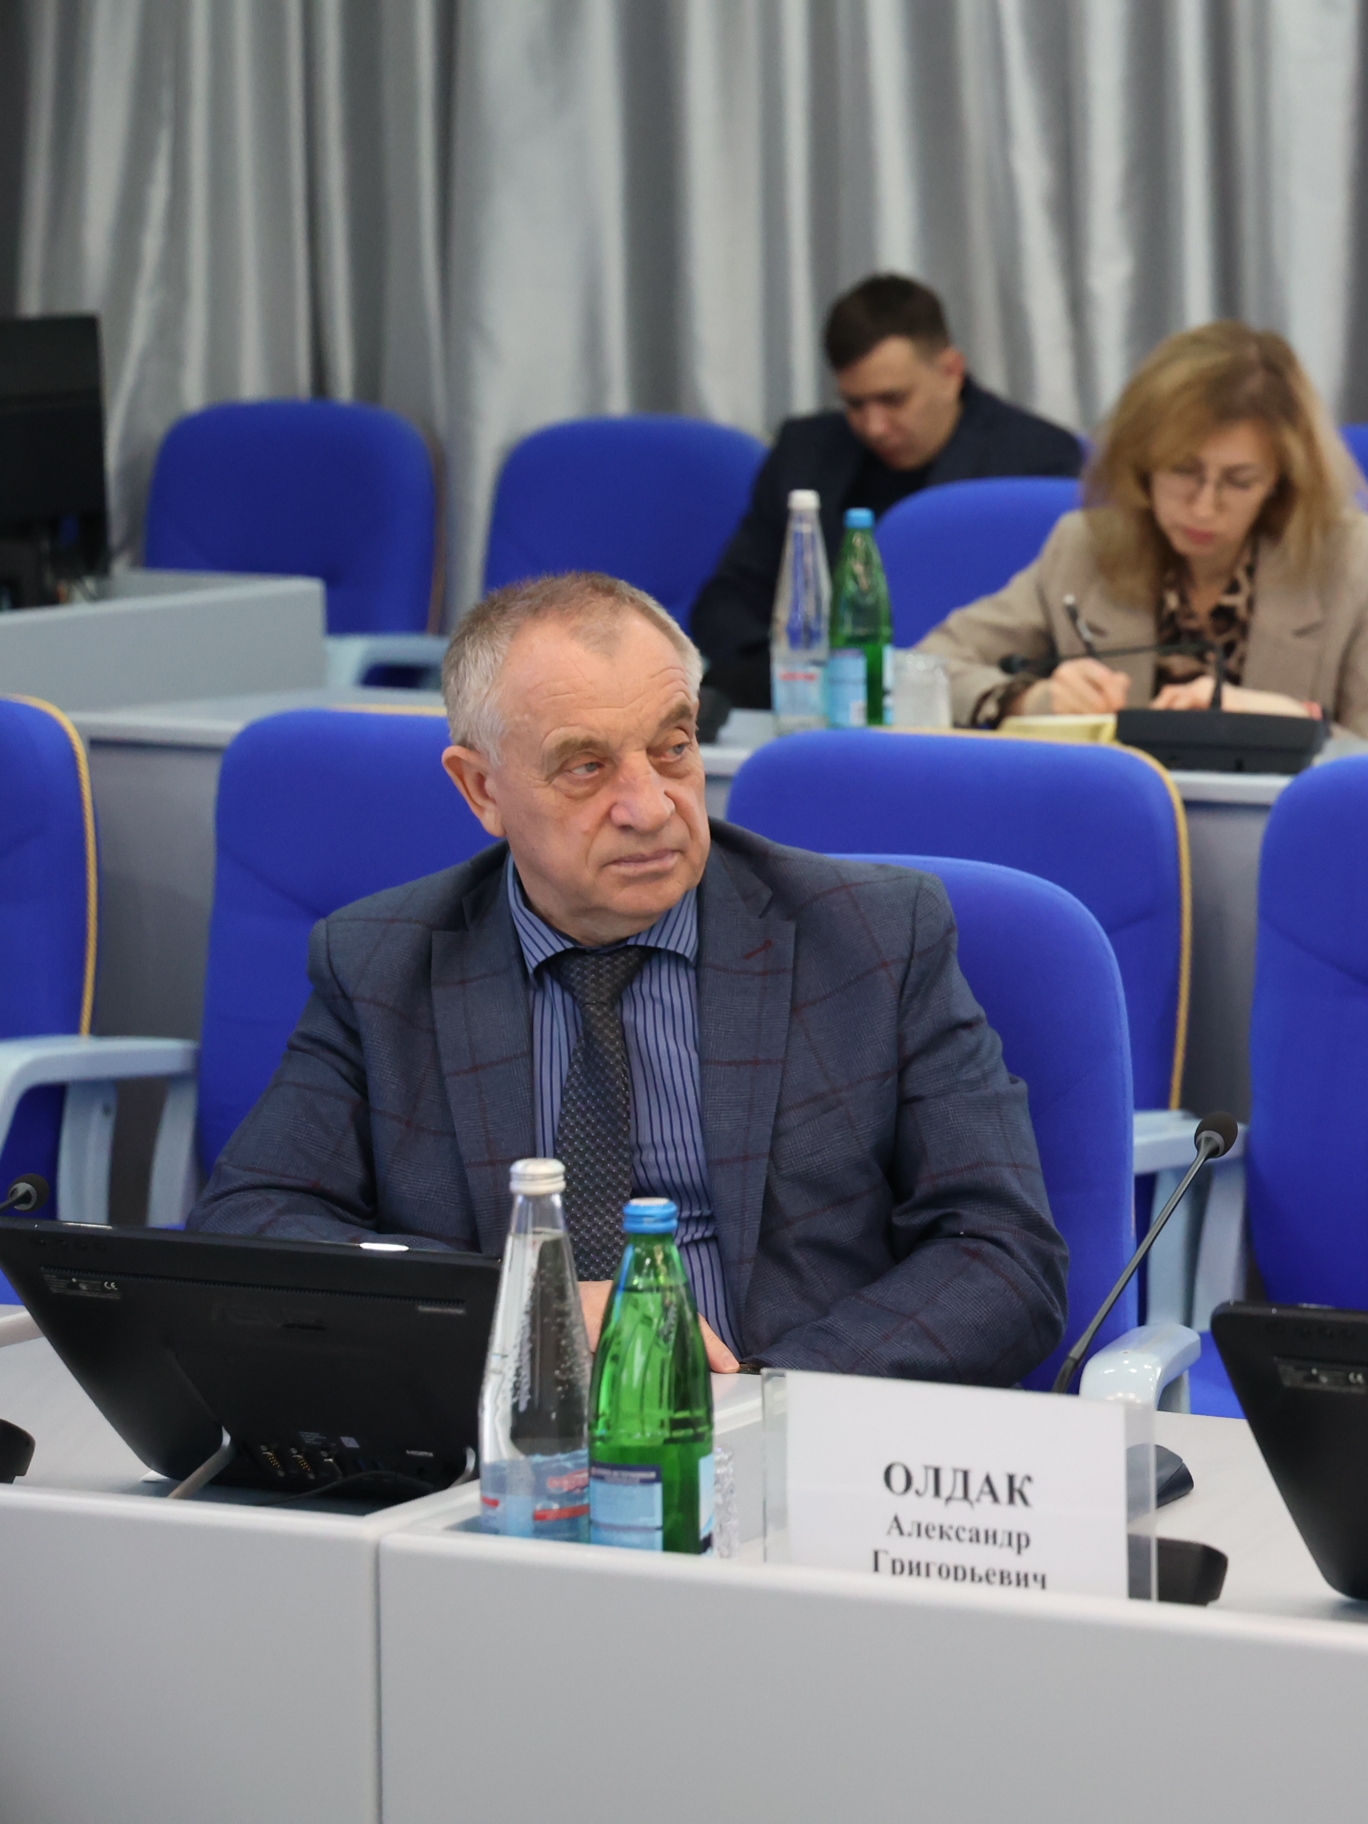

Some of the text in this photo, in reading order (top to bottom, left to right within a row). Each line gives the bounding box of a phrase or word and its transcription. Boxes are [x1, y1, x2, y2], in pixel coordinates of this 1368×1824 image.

[883, 1461, 1032, 1509] ОЛДАК
[886, 1512, 1031, 1556] Александр
[872, 1549, 1047, 1589] Григорьевич
